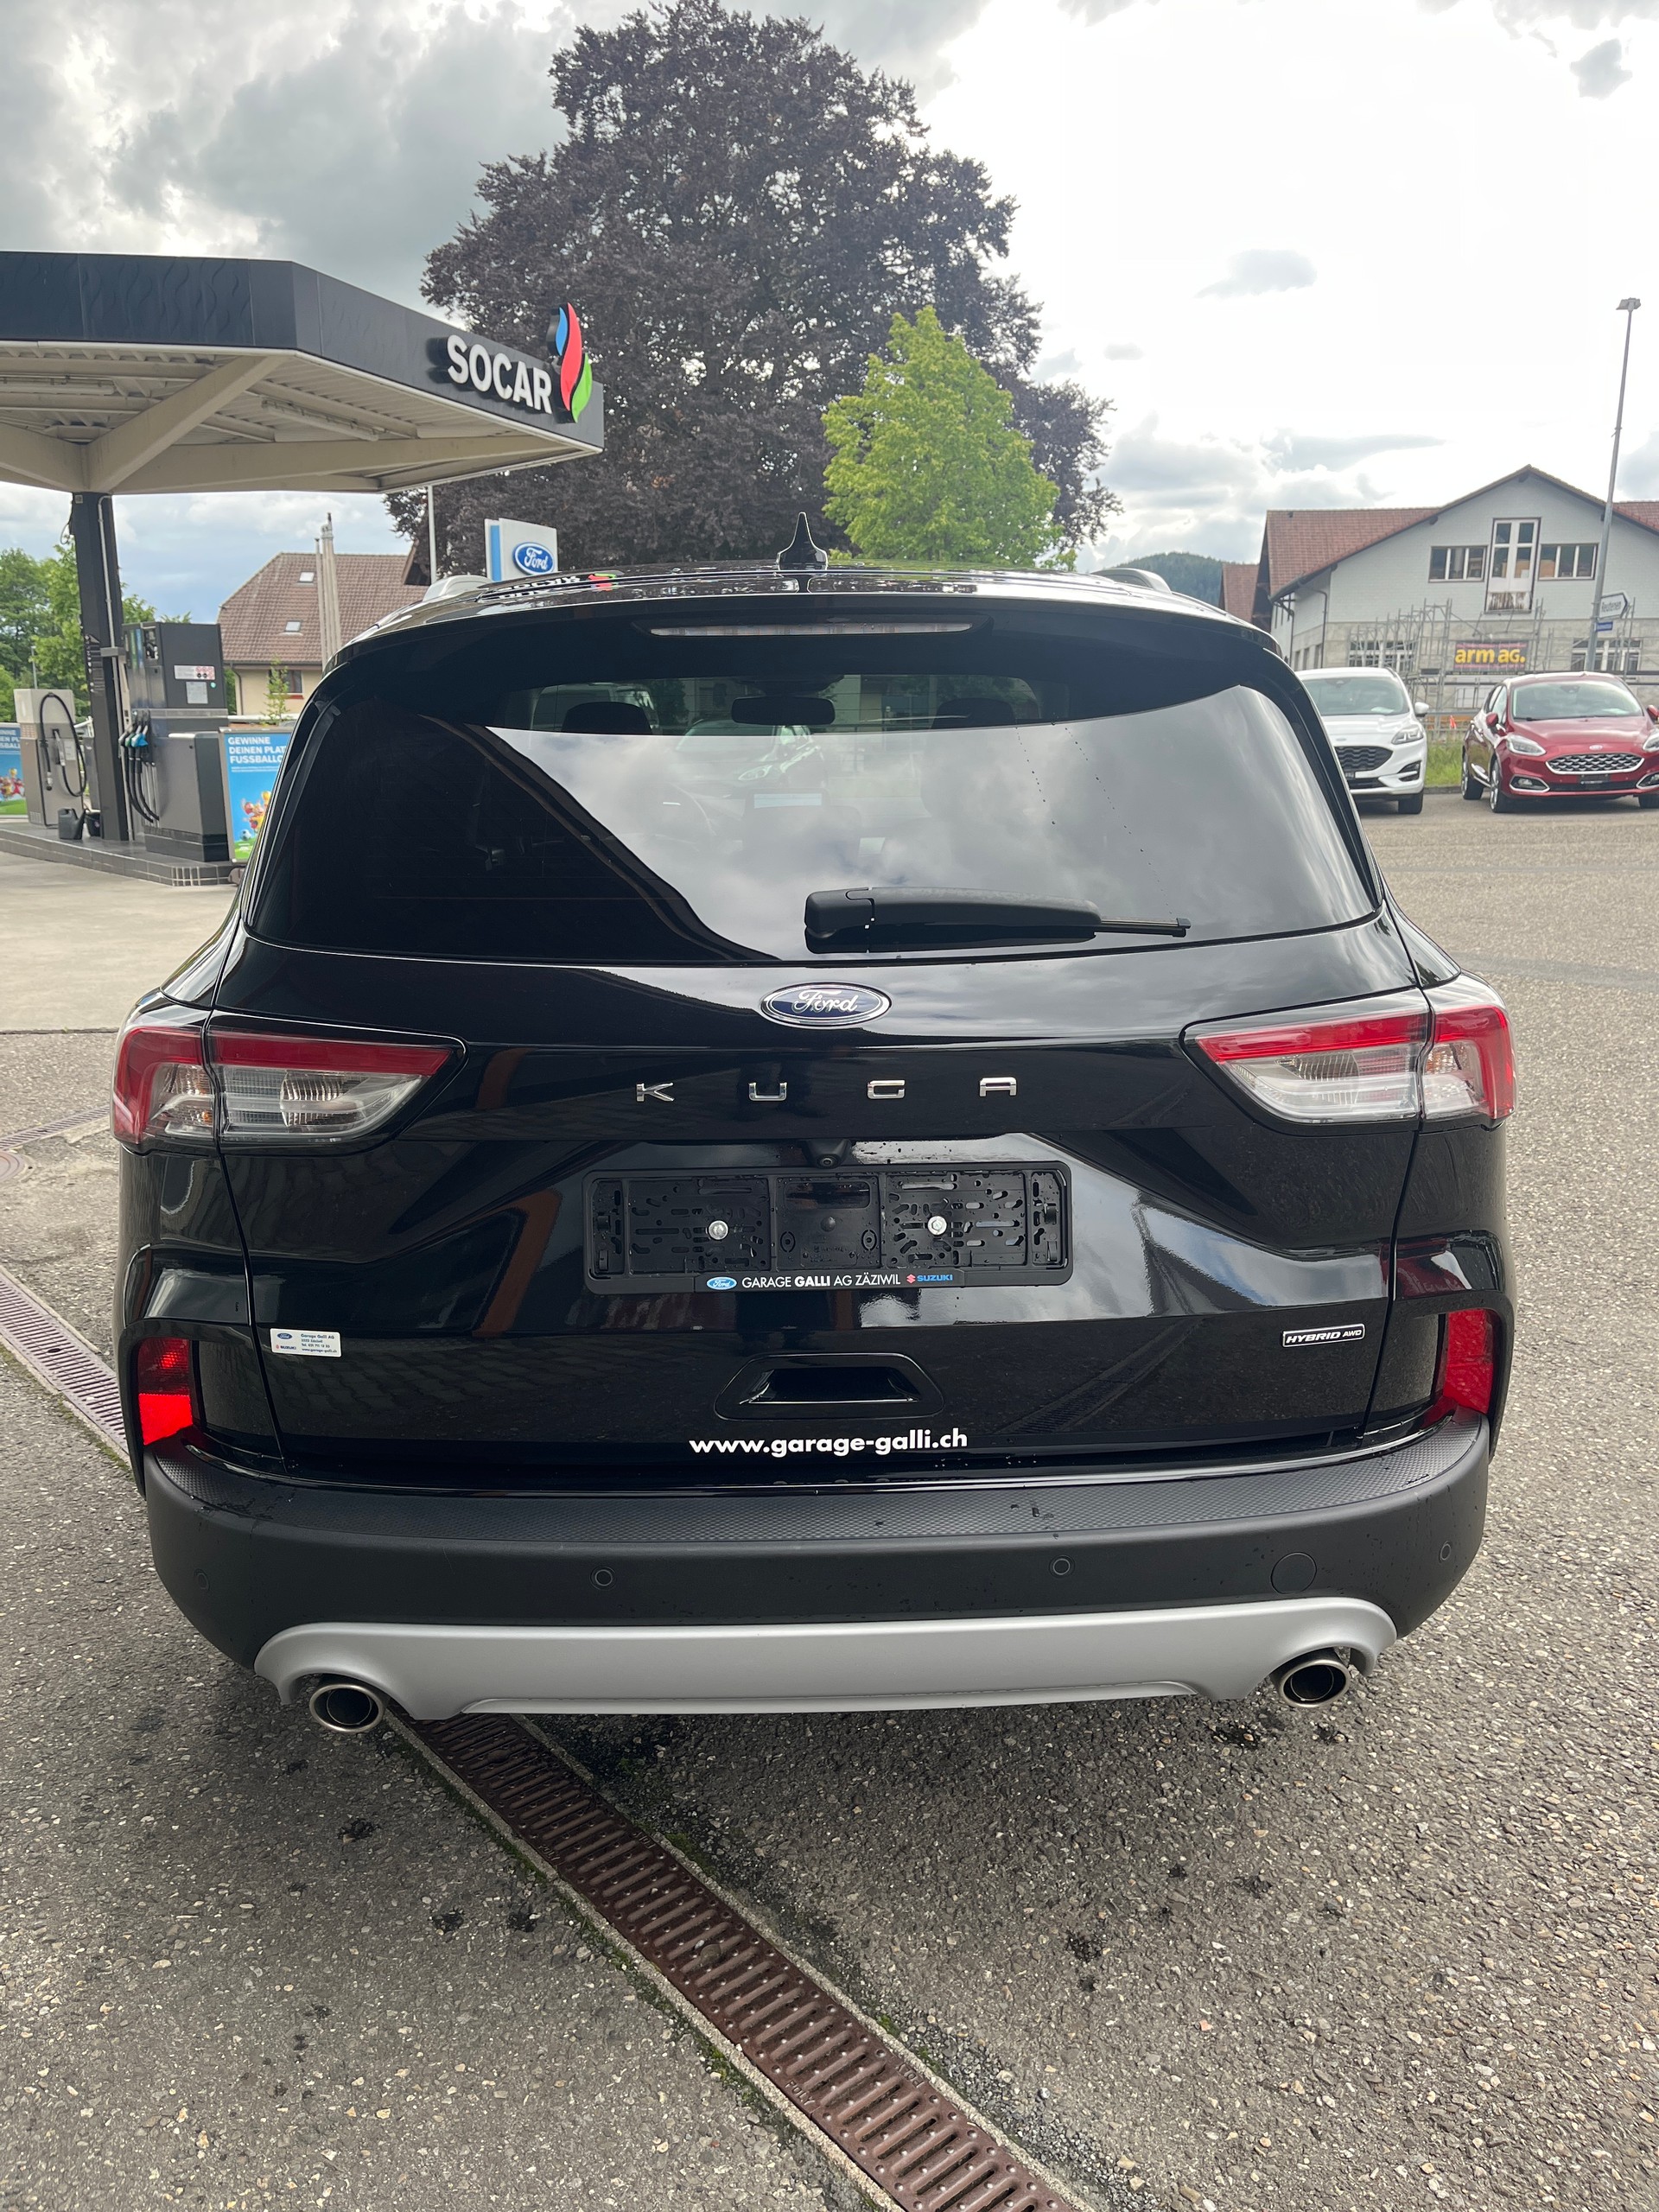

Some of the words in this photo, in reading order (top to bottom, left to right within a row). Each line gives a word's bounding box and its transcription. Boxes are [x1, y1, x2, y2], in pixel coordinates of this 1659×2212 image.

[447, 334, 553, 415] SOCAR
[1454, 648, 1495, 664] arm
[227, 736, 270, 745] GEWINNE
[228, 746, 263, 754] DEINEN
[792, 989, 859, 1014] Ford
[636, 1077, 1017, 1103] KUGA
[741, 1276, 792, 1288] GARAGE
[794, 1275, 830, 1287] GALLI
[833, 1275, 853, 1287] AG
[855, 1272, 901, 1286] ZÄZIWIL
[917, 1274, 953, 1282] SUZUKI
[1286, 1331, 1342, 1344] HYBRID
[1342, 1329, 1363, 1338] AWD
[689, 1427, 968, 1458] www.garage-galli.ch
